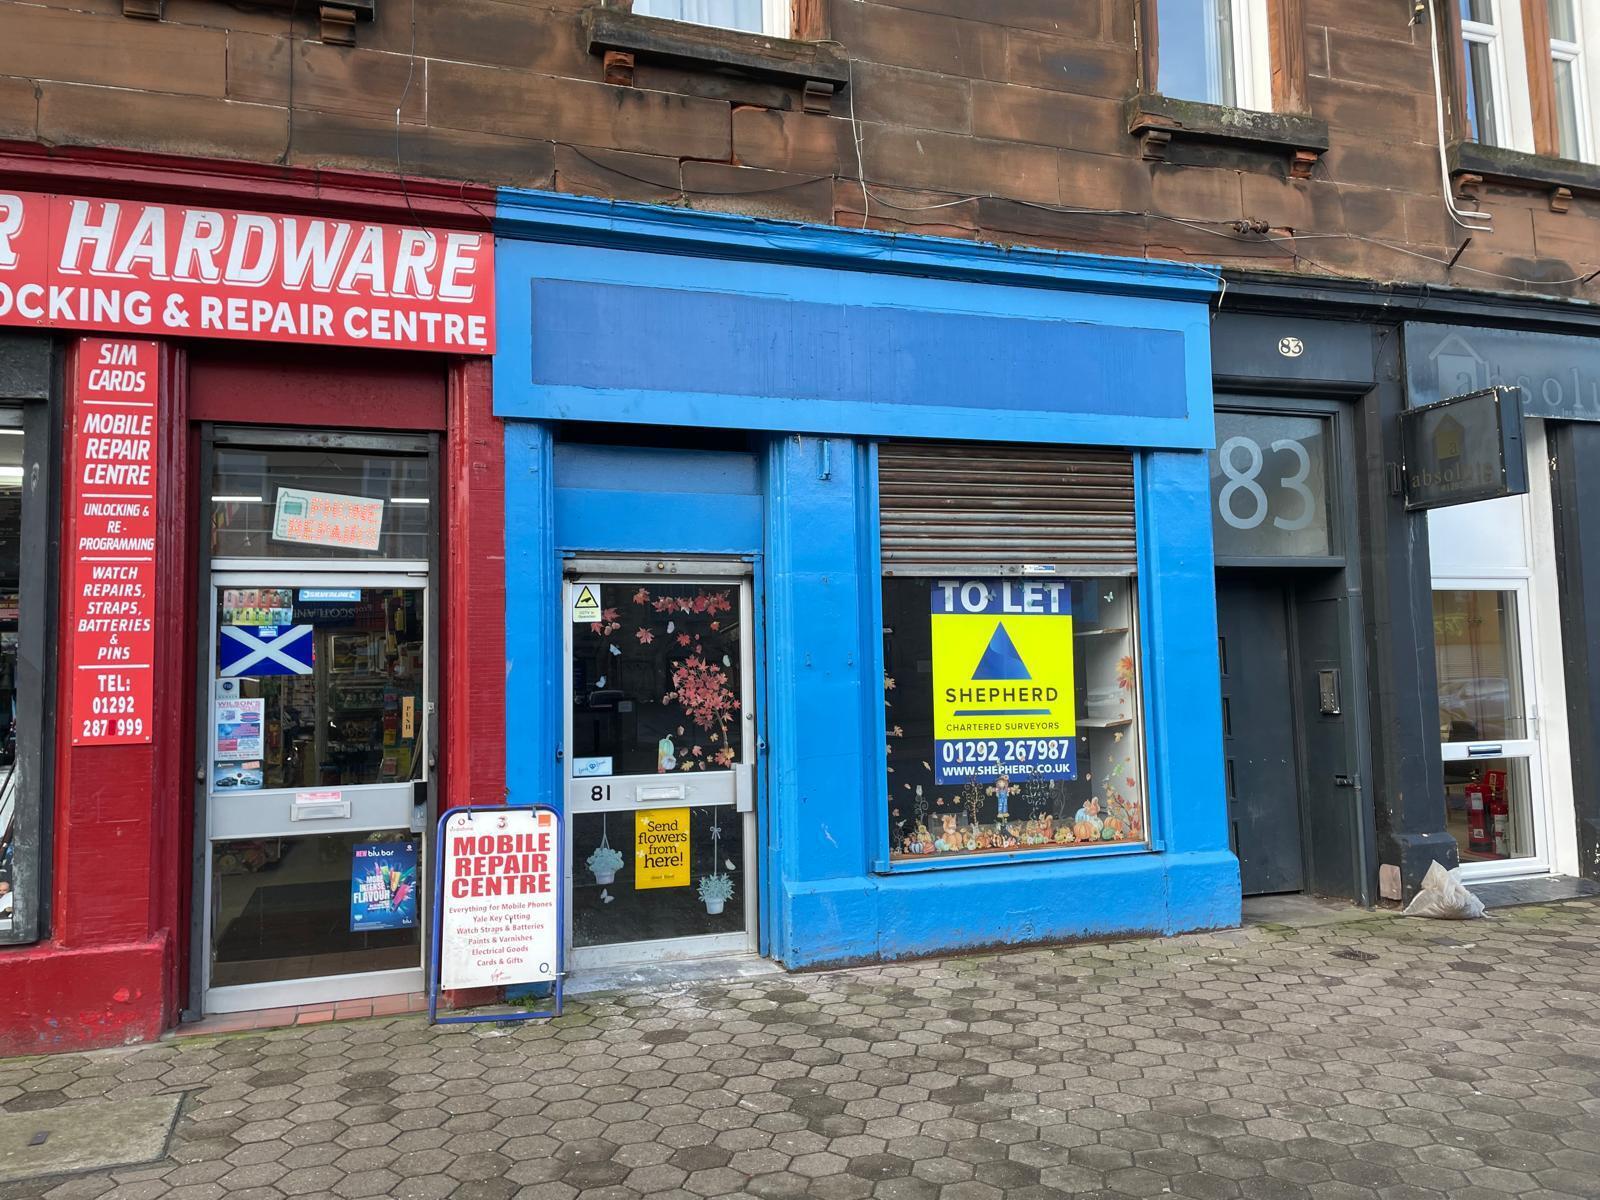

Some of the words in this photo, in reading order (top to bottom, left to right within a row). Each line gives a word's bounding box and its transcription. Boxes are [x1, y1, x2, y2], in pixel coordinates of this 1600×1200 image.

[58, 200, 480, 303] HARDWARE
[163, 293, 190, 327] &
[201, 296, 335, 337] REPAIR
[344, 308, 488, 346] CENTRE
[1281, 339, 1302, 354] 83
[98, 344, 137, 366] SIM
[88, 369, 146, 392] CARDS
[83, 413, 153, 435] MOBILE
[86, 438, 150, 460] REPAIR
[83, 464, 151, 485] CENTRE
[1219, 436, 1316, 530] 83
[84, 503, 140, 516] UNLOCKING
[142, 505, 150, 516] &
[79, 538, 154, 551] PROGRAMMING
[92, 567, 138, 580] WATCH
[83, 584, 146, 598] REPAIRS,
[938, 581, 989, 612] TO
[1003, 582, 1064, 613] LET
[87, 602, 141, 615] STRAPS,
[78, 619, 150, 632] BATTERIES
[110, 634, 118, 644] &
[98, 647, 130, 660] PINS
[98, 675, 130, 692] TEL:
[946, 688, 1058, 703] SHEPHERD
[93, 696, 134, 714] 01292
[946, 723, 1001, 731] CHARTERED
[943, 741, 999, 762] 01292
[1005, 740, 1069, 761] 267987
[943, 764, 1070, 776] WWW.SHEPHERD.CO.UK
[591, 785, 611, 801] 81
[648, 820, 678, 832] Send
[454, 833, 550, 856] MOBILE
[638, 832, 687, 844] flowers
[649, 844, 677, 854] from
[455, 854, 547, 877] REPAIR
[644, 852, 683, 868] here!
[452, 874, 550, 898] CENTRE
[354, 890, 390, 904] FLAVOUR
[449, 905, 487, 913] Everything
[473, 915, 488, 923] Yale
[505, 913, 530, 921] Cutting
[457, 925, 478, 934] Watch
[480, 925, 503, 933] Straps
[469, 937, 490, 945] Paints
[472, 947, 504, 956] Electrical
[477, 957, 497, 966] Cards
